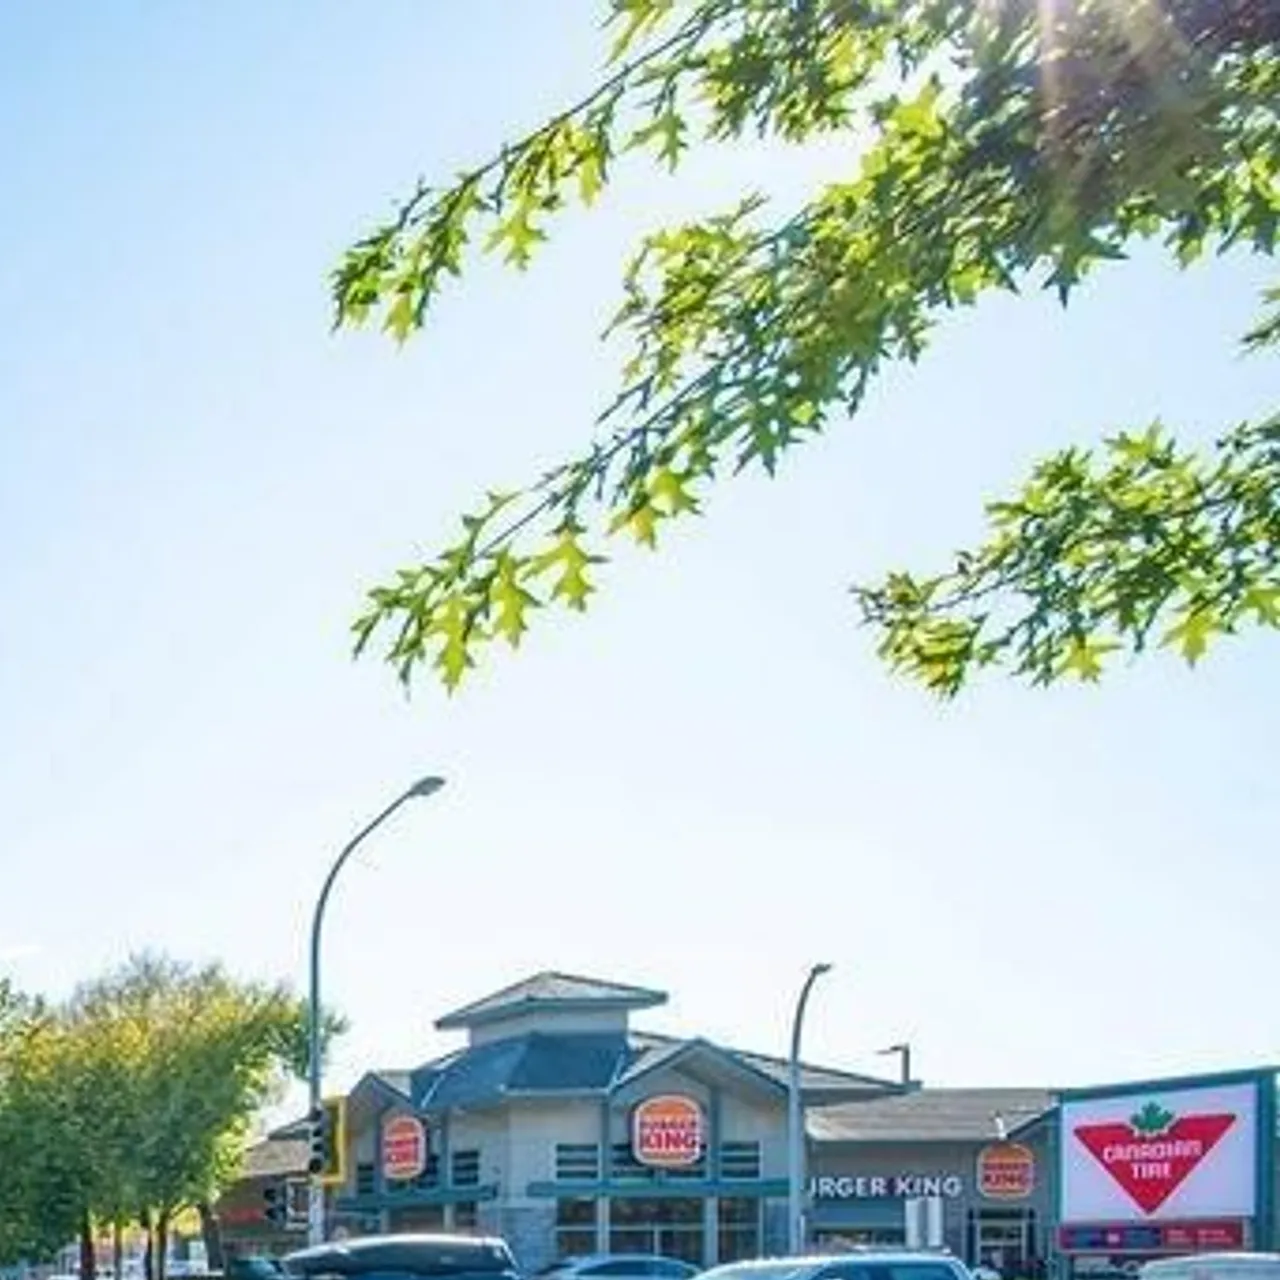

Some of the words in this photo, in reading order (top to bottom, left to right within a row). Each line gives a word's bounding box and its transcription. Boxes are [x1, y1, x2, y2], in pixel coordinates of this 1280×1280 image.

[1103, 1140, 1203, 1162] CANADIAN
[1131, 1162, 1173, 1180] TIRE
[896, 1176, 963, 1198] KING
